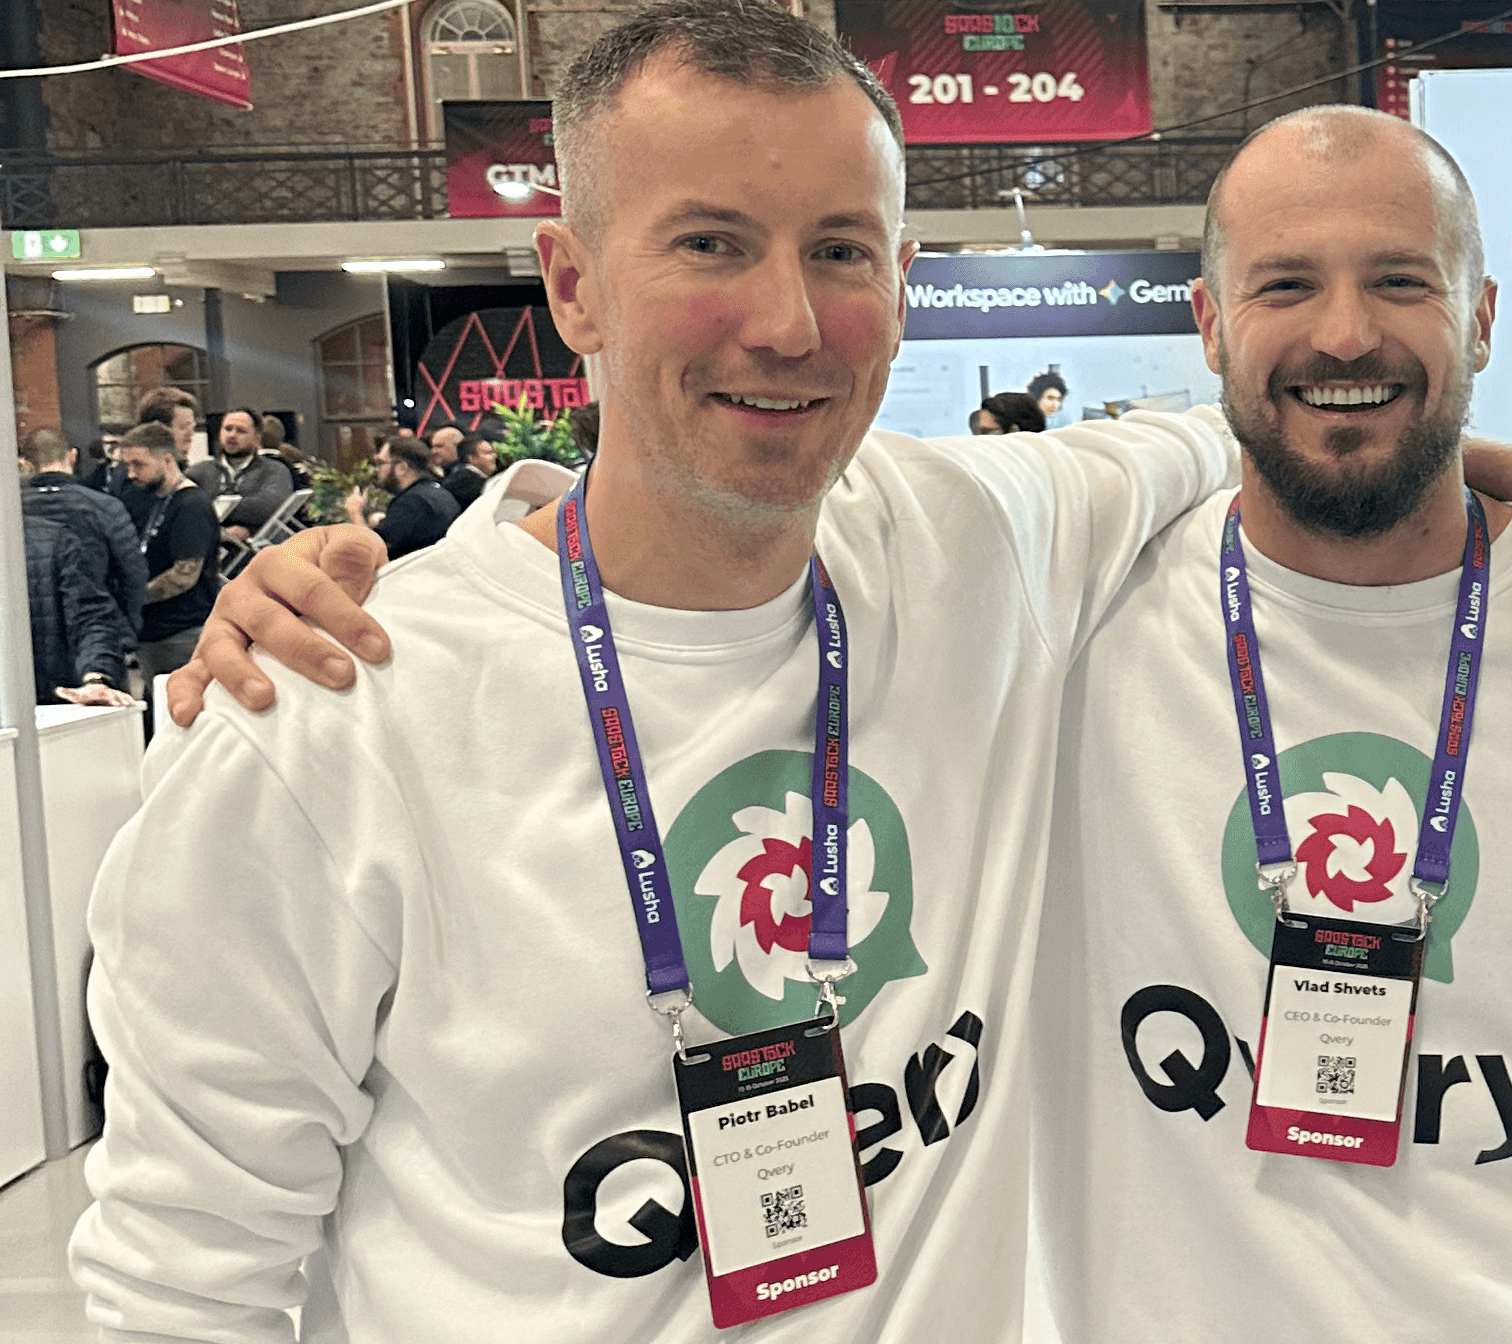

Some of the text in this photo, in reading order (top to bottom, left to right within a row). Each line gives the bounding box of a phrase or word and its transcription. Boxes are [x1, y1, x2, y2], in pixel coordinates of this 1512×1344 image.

[907, 71, 1085, 104] 201 - 204
[906, 284, 1042, 313] Workspace
[1043, 281, 1097, 306] with
[1227, 582, 1243, 622] Lusha
[1465, 581, 1482, 622] Lusha
[826, 603, 842, 648] Lusha
[586, 644, 609, 692] Lusha
[1255, 771, 1272, 816] Lusha
[1435, 770, 1456, 814] Lusha
[823, 823, 838, 874] Lusha
[638, 871, 661, 924] Lusha
[1294, 980, 1386, 997] Vlad Shvets
[1284, 1011, 1392, 1027] CEO & Co-Founder
[1319, 1034, 1354, 1046] Qvery
[718, 1094, 815, 1131] Piotr Babel
[713, 1129, 830, 1167] CTO & Co-Founder
[1287, 1126, 1364, 1149] Sponsor
[757, 1162, 795, 1181] Qvery
[757, 1264, 839, 1301] Sponsor
